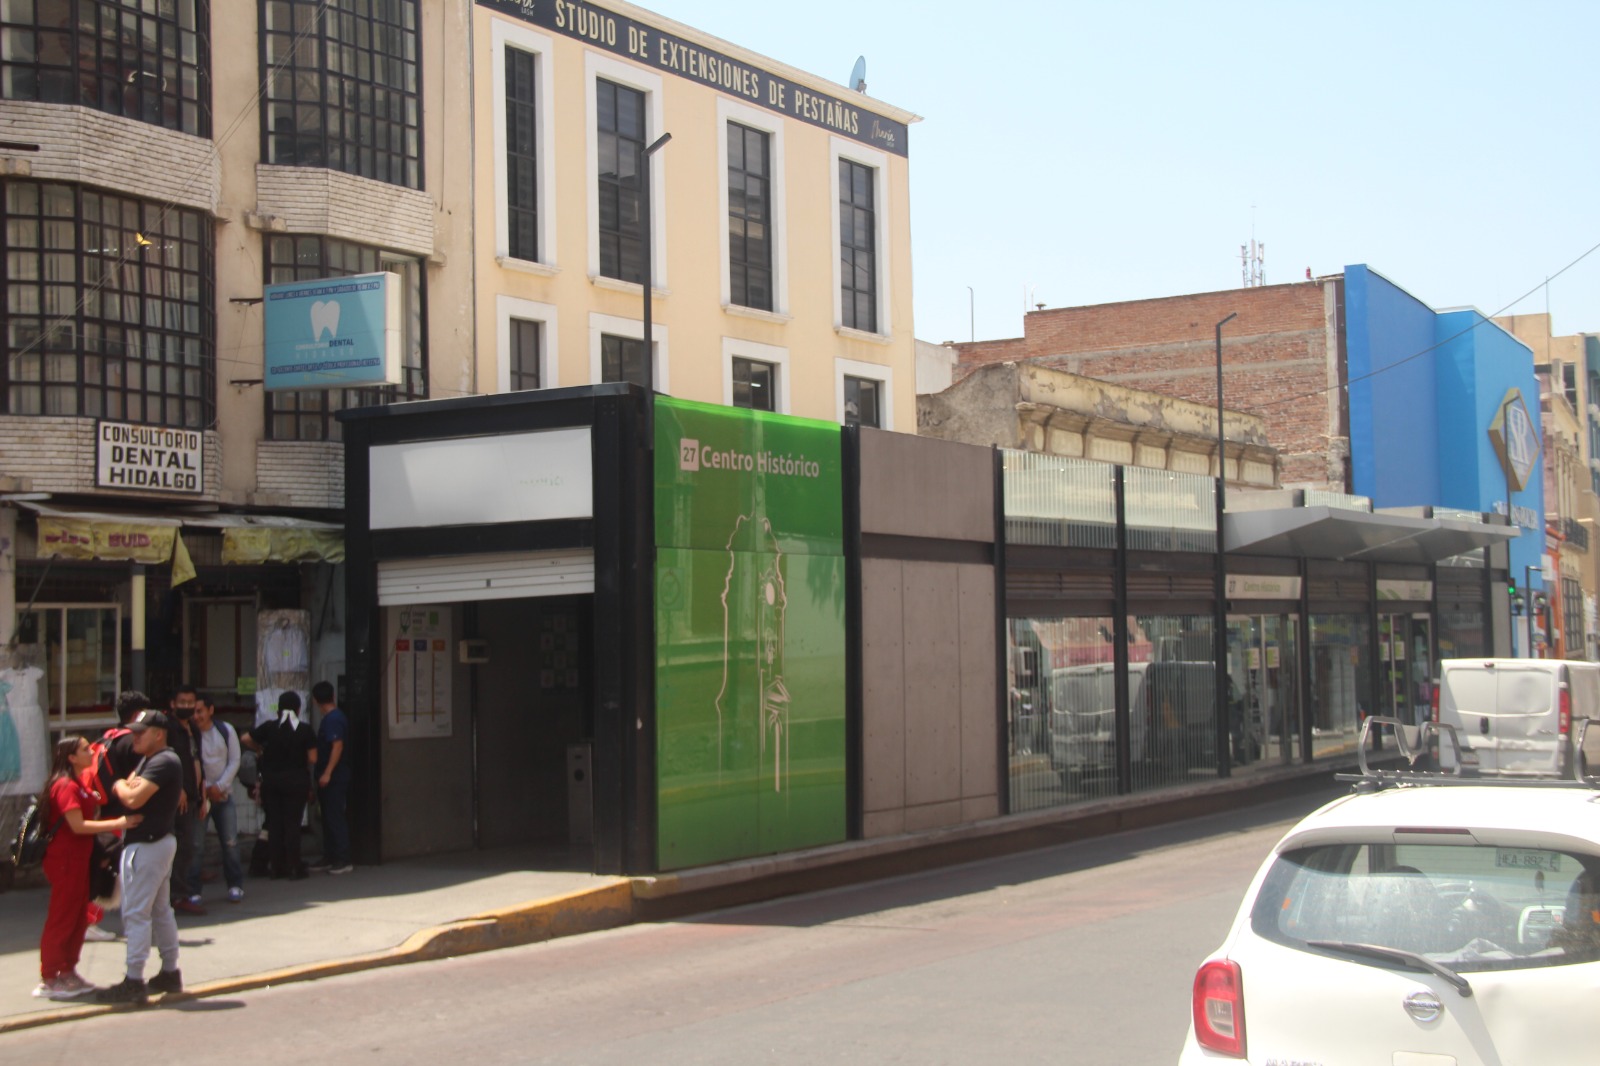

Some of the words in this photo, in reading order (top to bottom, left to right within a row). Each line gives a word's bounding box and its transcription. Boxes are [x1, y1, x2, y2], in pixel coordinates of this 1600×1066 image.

[555, 0, 616, 46] STUDIO
[628, 26, 648, 58] DE
[660, 38, 759, 99] EXTENSIONES
[769, 80, 785, 109] DE
[795, 90, 859, 135] PESTAÑAS
[329, 339, 354, 348] DENTAL
[103, 425, 198, 450] CONSULTORIO
[112, 445, 197, 470] DENTAL
[683, 446, 697, 463] 27
[701, 446, 753, 471] Centro
[757, 450, 819, 478] Histórico
[110, 467, 197, 490] HIDALGO
